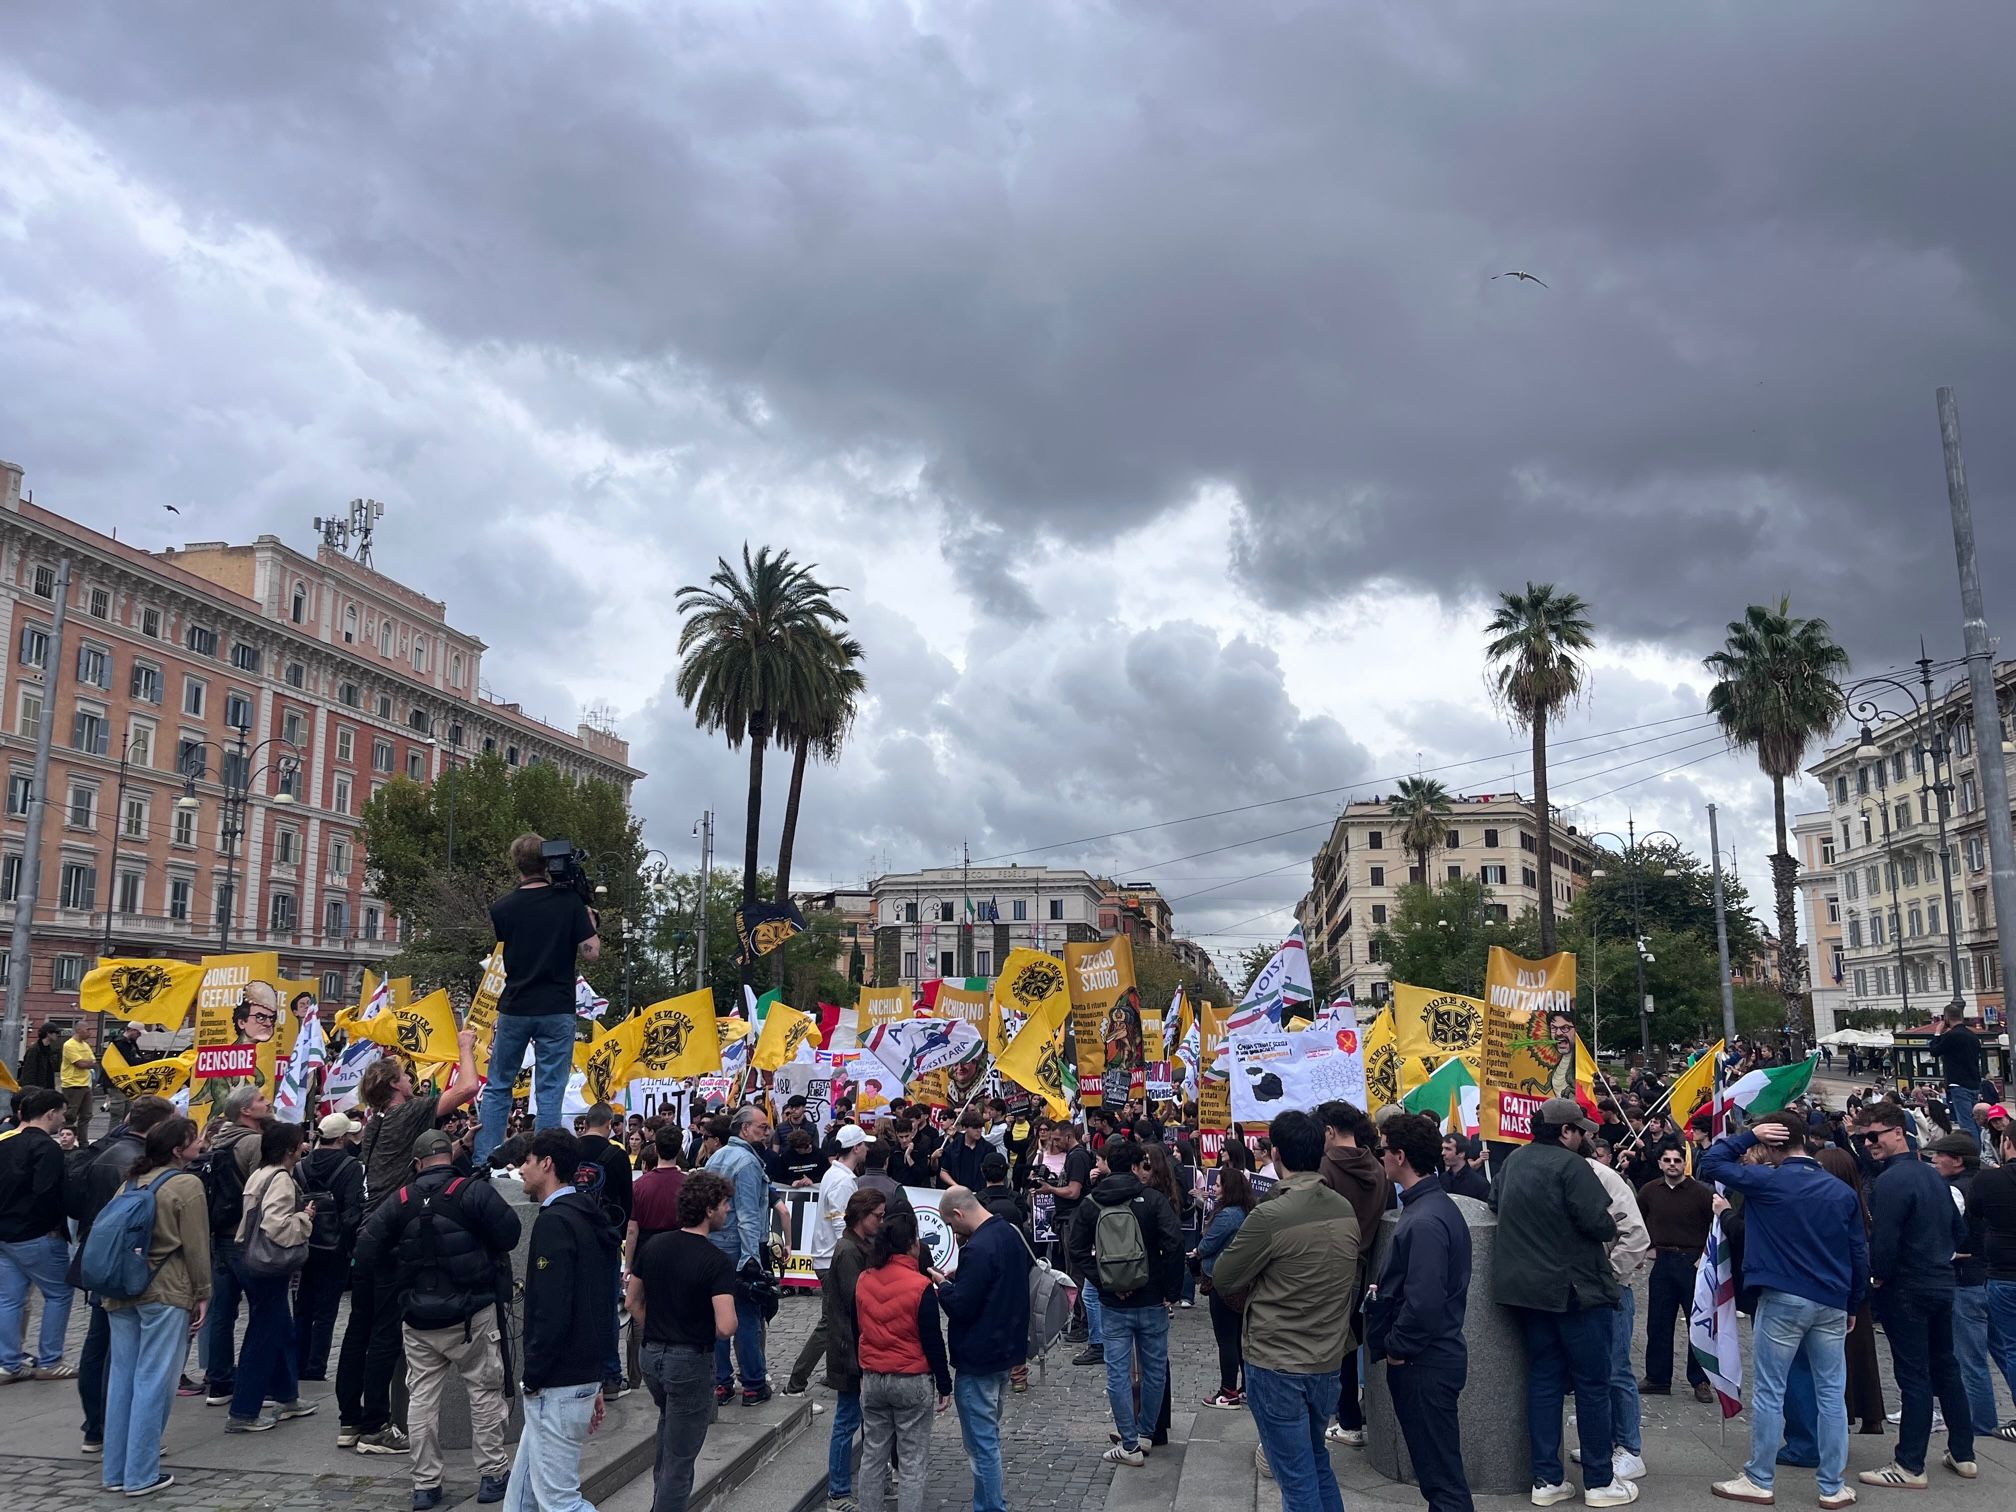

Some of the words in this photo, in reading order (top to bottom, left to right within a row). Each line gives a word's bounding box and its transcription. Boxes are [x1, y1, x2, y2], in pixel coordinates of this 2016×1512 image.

[999, 870, 1027, 878] FEDELE
[1080, 949, 1115, 972] ZECCO
[202, 967, 249, 987] BONELLI
[1081, 969, 1120, 992] SAURO
[1517, 968, 1546, 989] DILO
[1490, 985, 1571, 1012] MONTANARI
[1420, 996, 1457, 1023] AZIONE
[198, 1049, 254, 1072] CENSORE
[811, 1081, 831, 1089] LISTA
[1504, 1096, 1543, 1115] CATTIV
[1501, 1114, 1531, 1134] MAES
